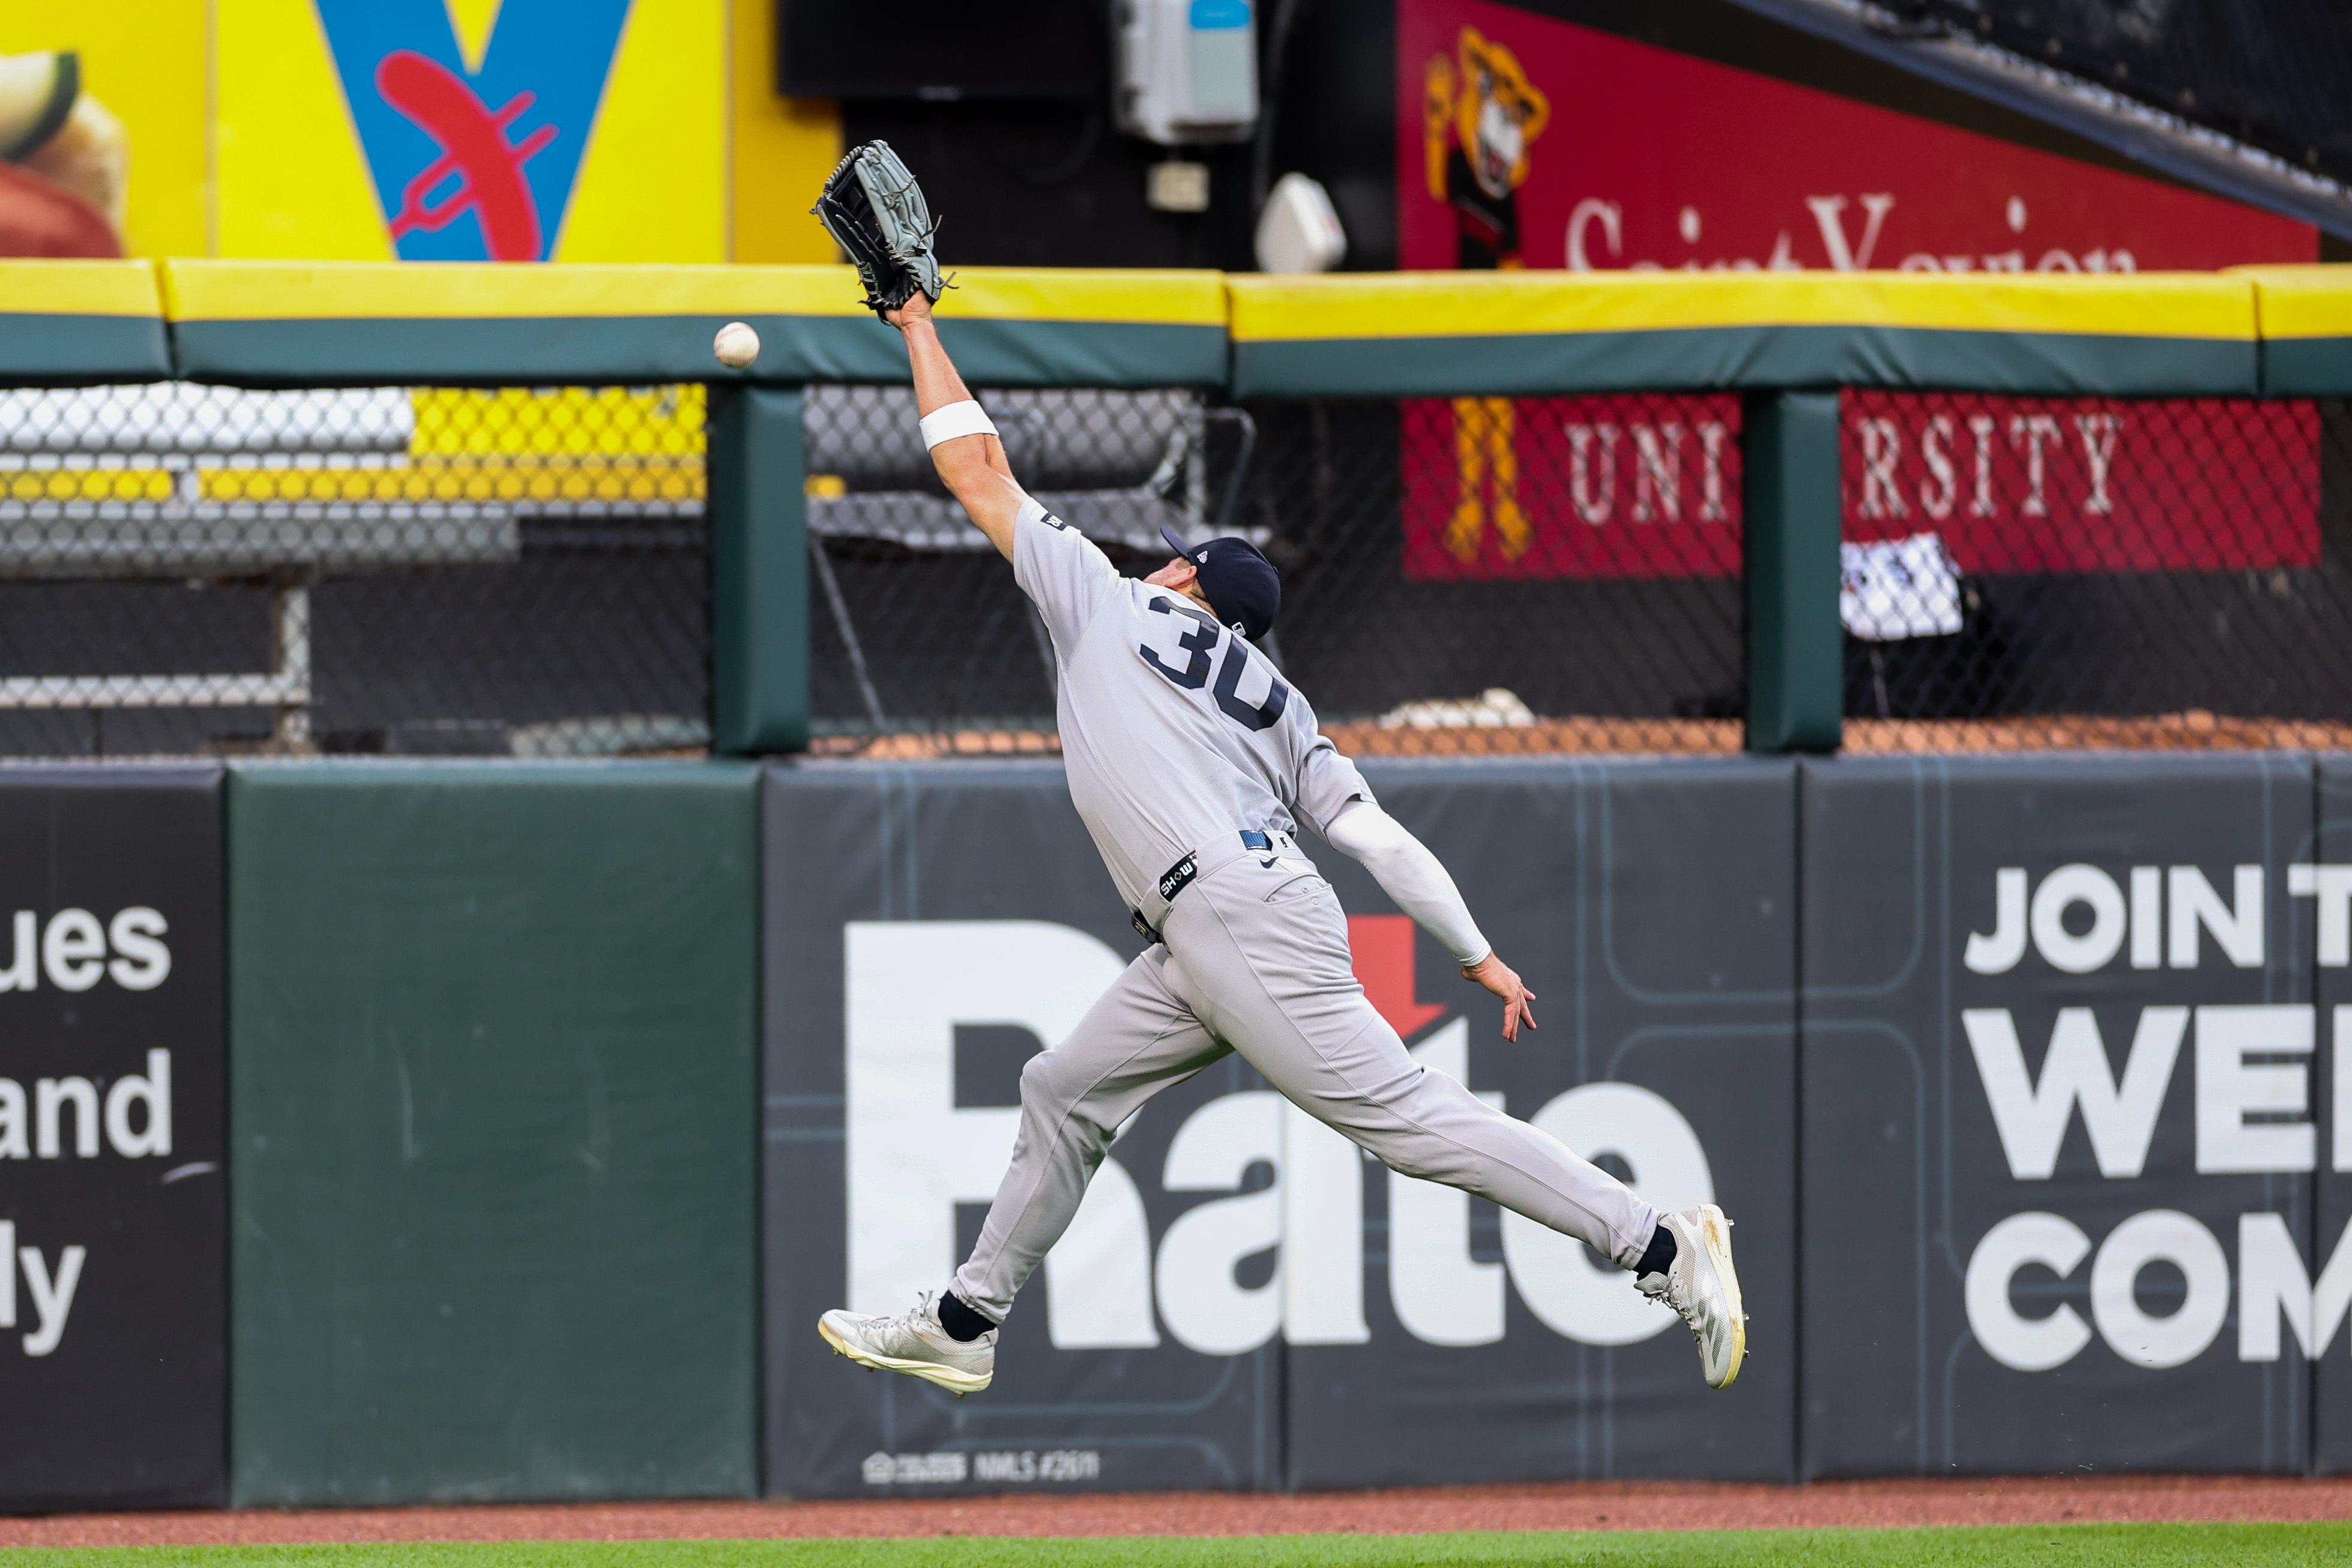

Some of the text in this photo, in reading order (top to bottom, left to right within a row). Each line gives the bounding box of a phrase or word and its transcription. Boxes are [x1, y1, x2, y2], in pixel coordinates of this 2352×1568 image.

[1564, 413, 2122, 526] UNIRSITY
[1140, 596, 1289, 732] 30
[1964, 864, 2265, 974] JOIN
[844, 920, 1715, 1356] Rate
[1961, 1004, 2352, 1180] WE
